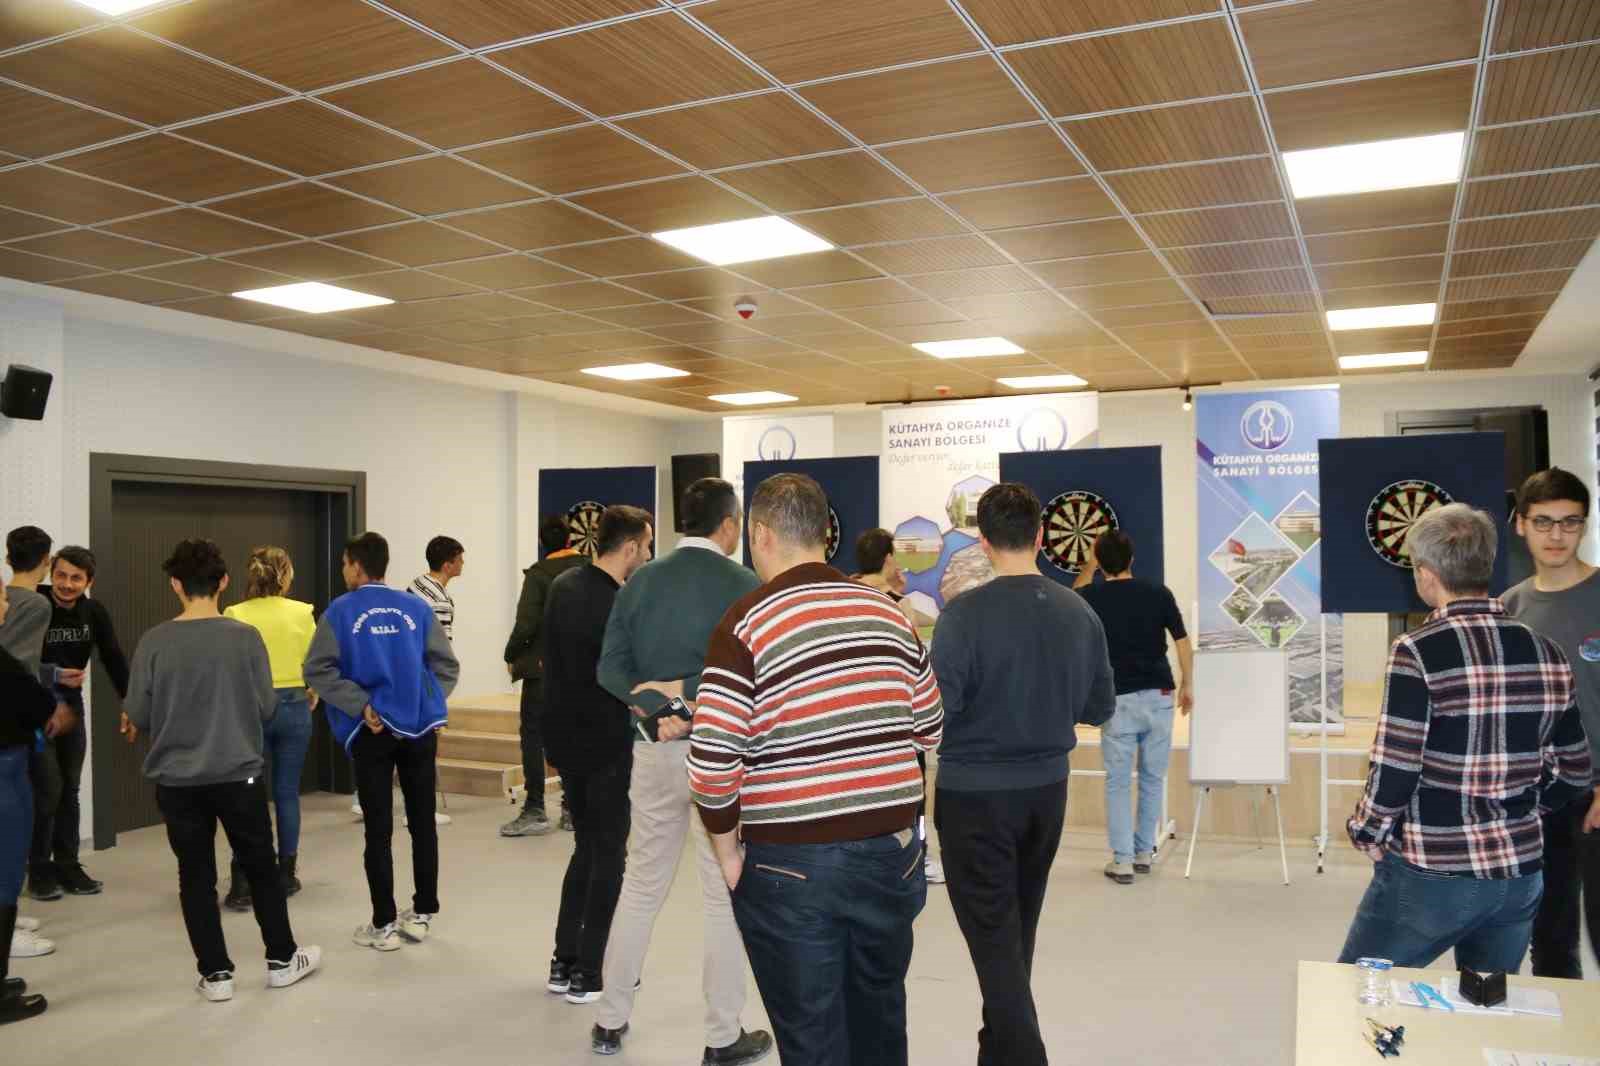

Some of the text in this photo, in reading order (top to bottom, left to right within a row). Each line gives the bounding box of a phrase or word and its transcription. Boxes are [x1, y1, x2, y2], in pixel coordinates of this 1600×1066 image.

[888, 420, 943, 435] KÜTAHYA
[1212, 453, 1263, 465] KÜTAHYA
[1268, 463, 1319, 476] BÖLGES
